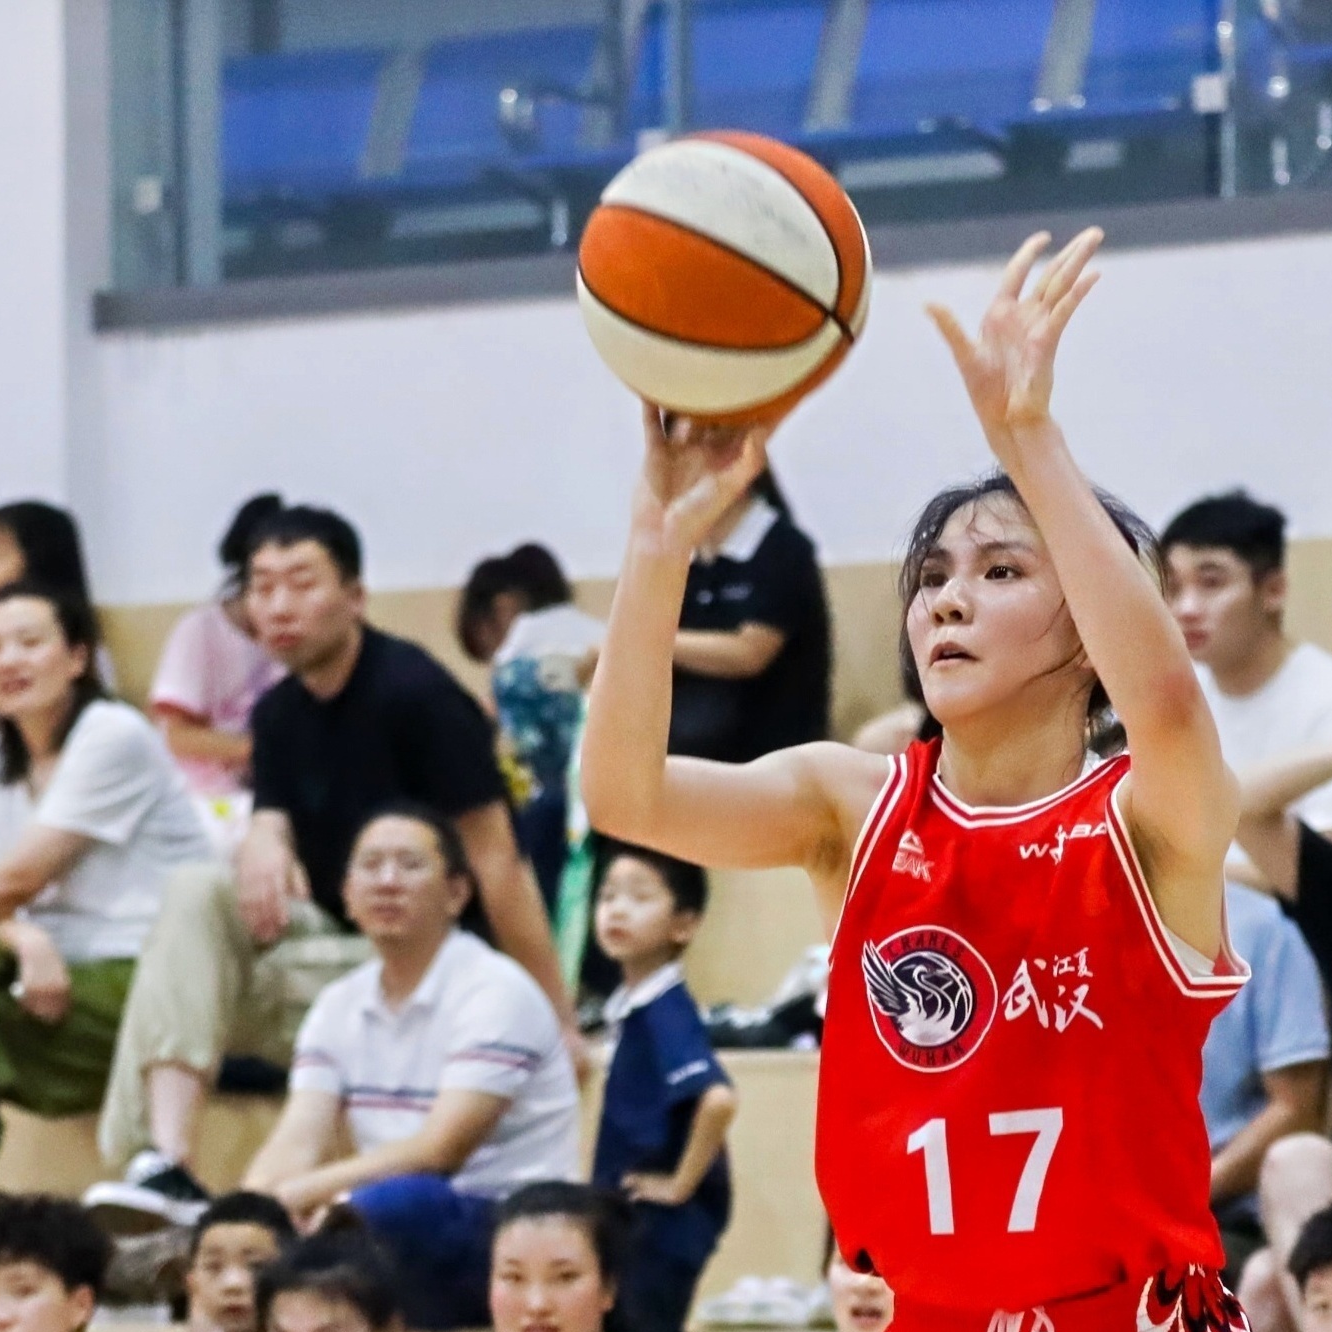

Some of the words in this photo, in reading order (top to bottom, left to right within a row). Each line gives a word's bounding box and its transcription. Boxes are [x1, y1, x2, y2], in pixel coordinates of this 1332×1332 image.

[891, 850, 935, 884] EAK
[1001, 957, 1104, 1034] 武汉
[906, 1106, 1064, 1236] 17
